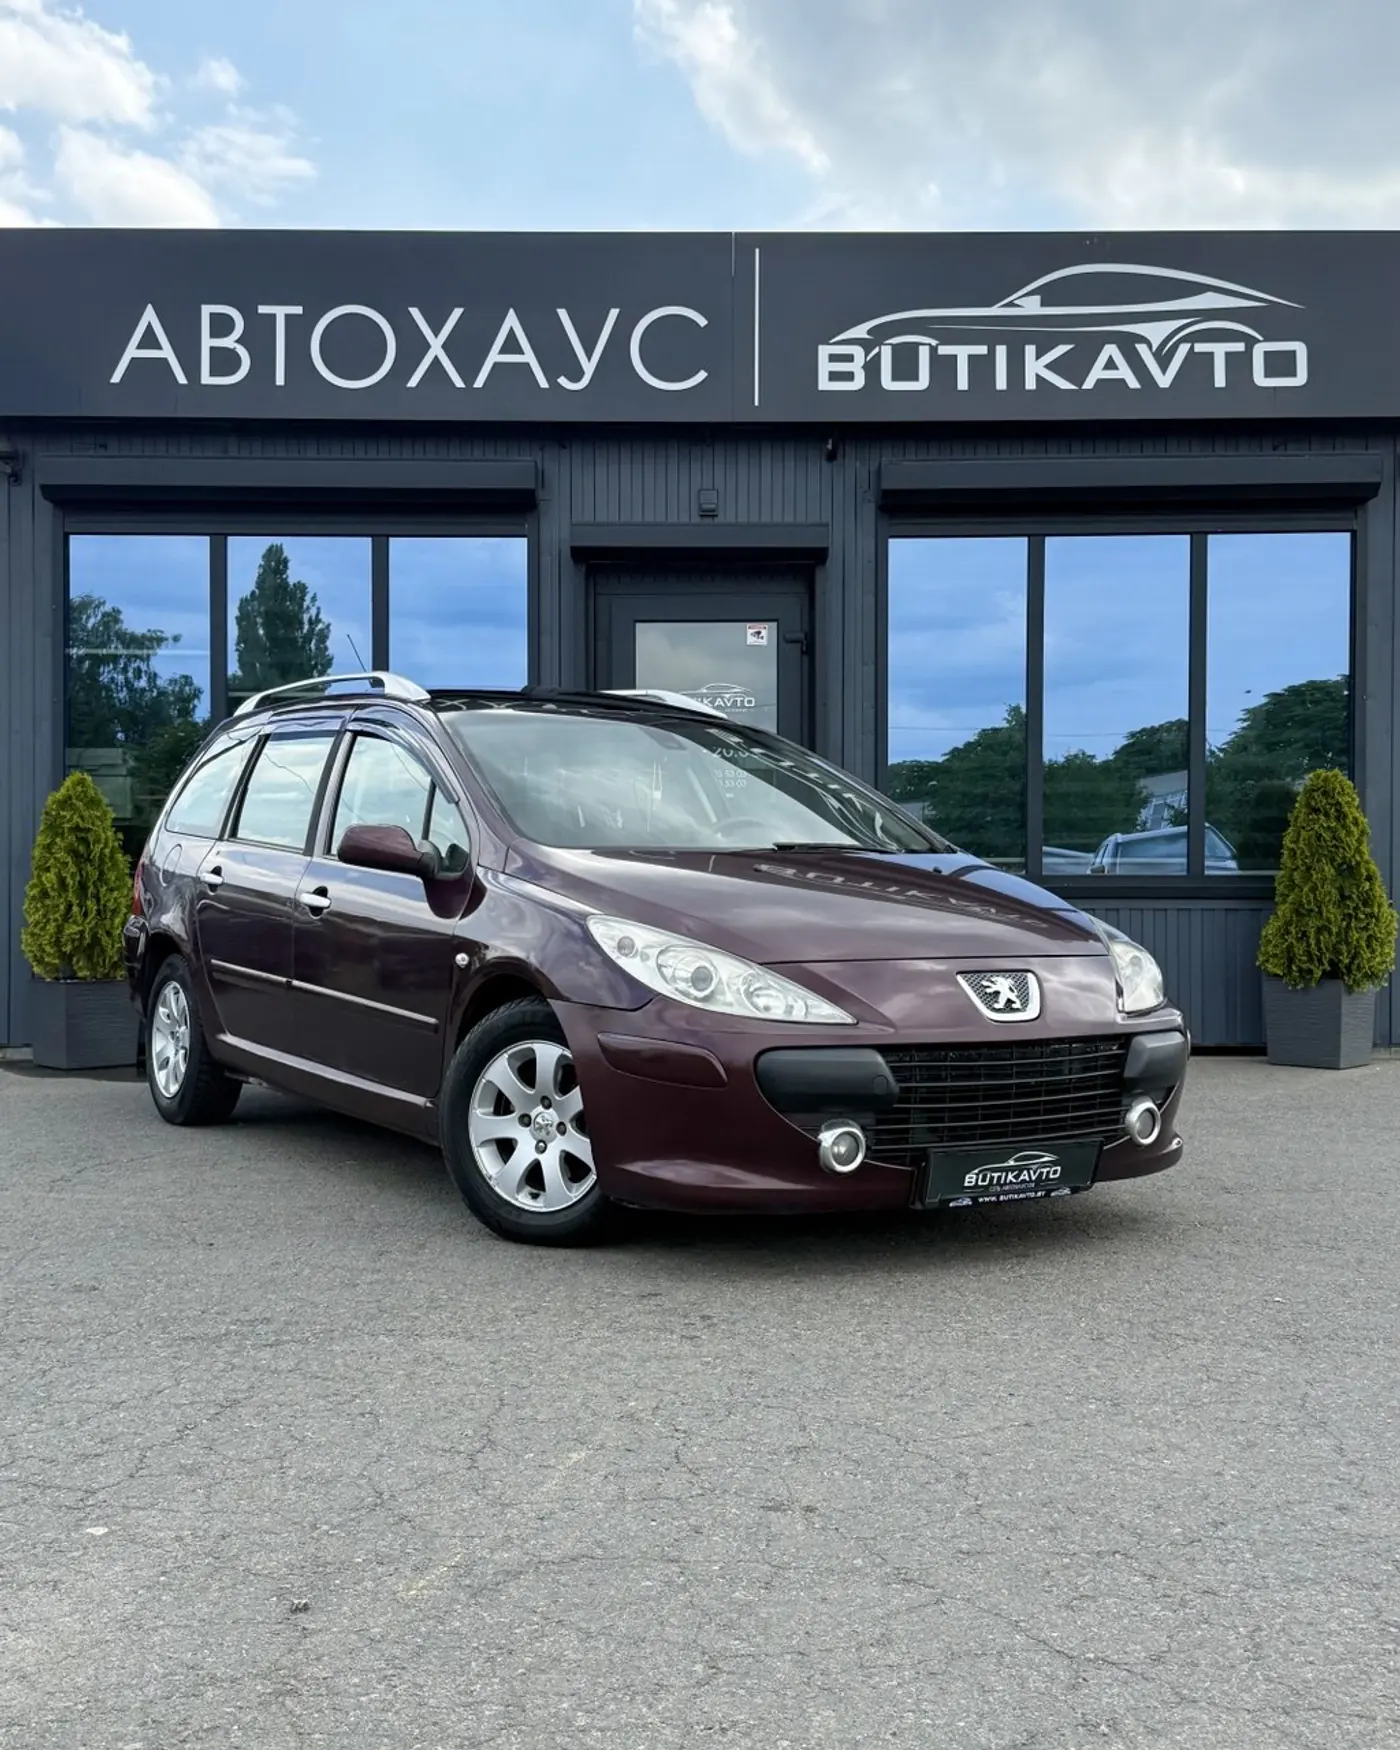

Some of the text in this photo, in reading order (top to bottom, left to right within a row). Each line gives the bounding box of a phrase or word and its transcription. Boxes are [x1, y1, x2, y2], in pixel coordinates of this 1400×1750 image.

[109, 303, 709, 391] АВТОХАУС
[817, 340, 1308, 391] BUTIKAVTO
[963, 1166, 1061, 1187] BUTIKAVTO
